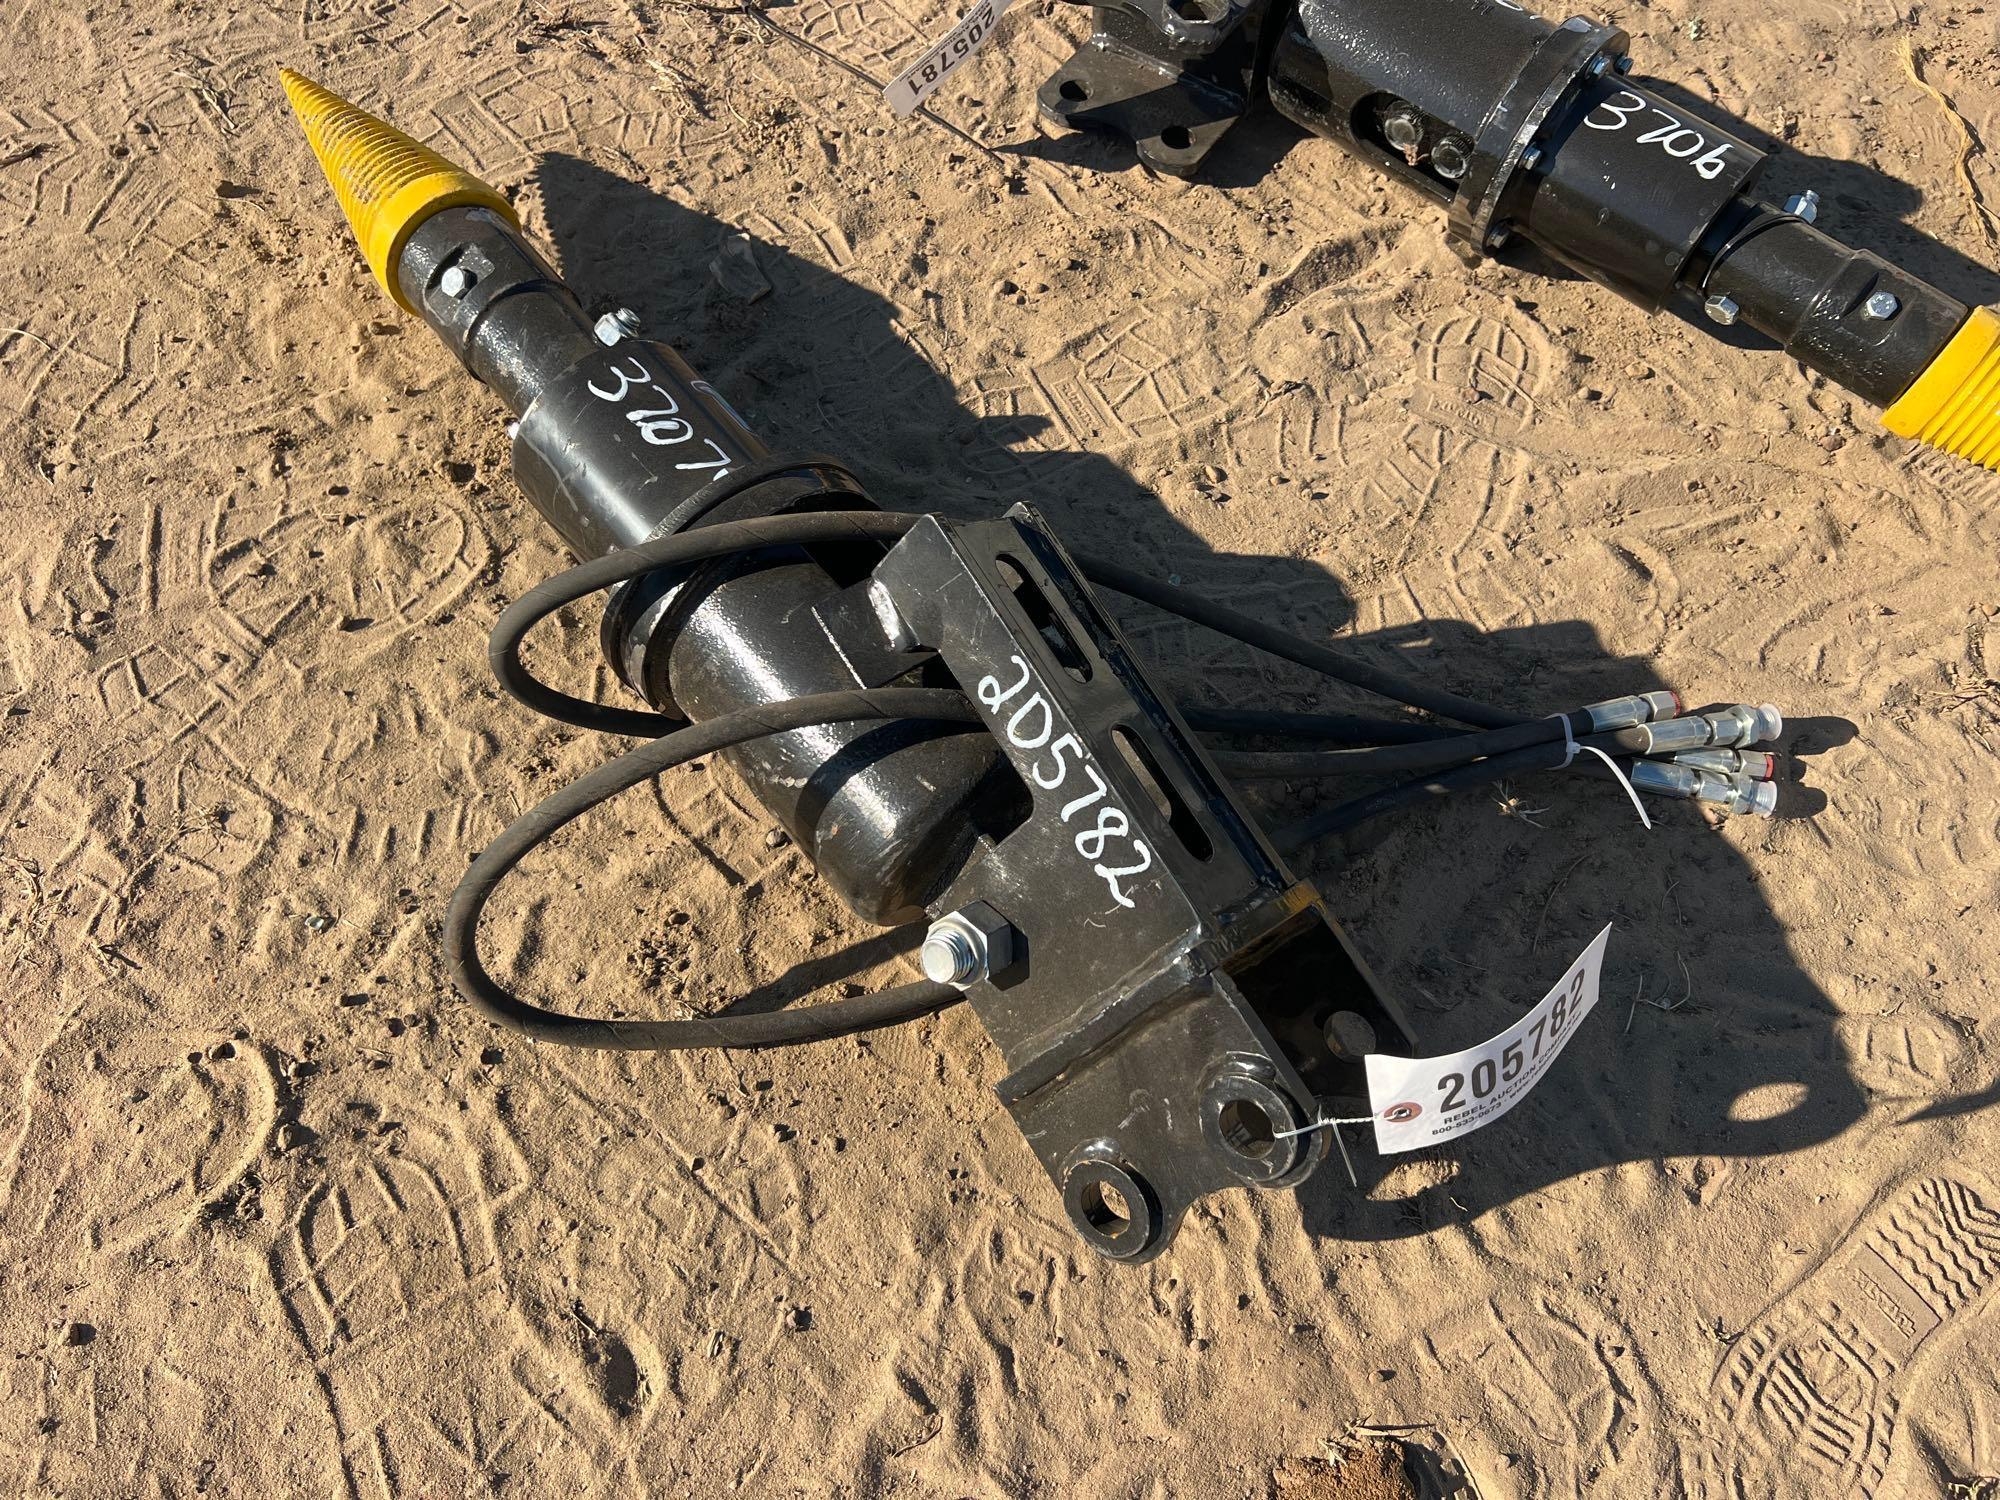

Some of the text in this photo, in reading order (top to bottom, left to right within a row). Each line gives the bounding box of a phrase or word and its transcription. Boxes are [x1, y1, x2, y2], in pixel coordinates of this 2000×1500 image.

[907, 6, 995, 96] 205781
[977, 655, 1151, 908] 205782
[1437, 968, 1586, 1113] 205782
[1444, 1104, 1487, 1124] REBEL
[1488, 1065, 1536, 1105] AUCTION
